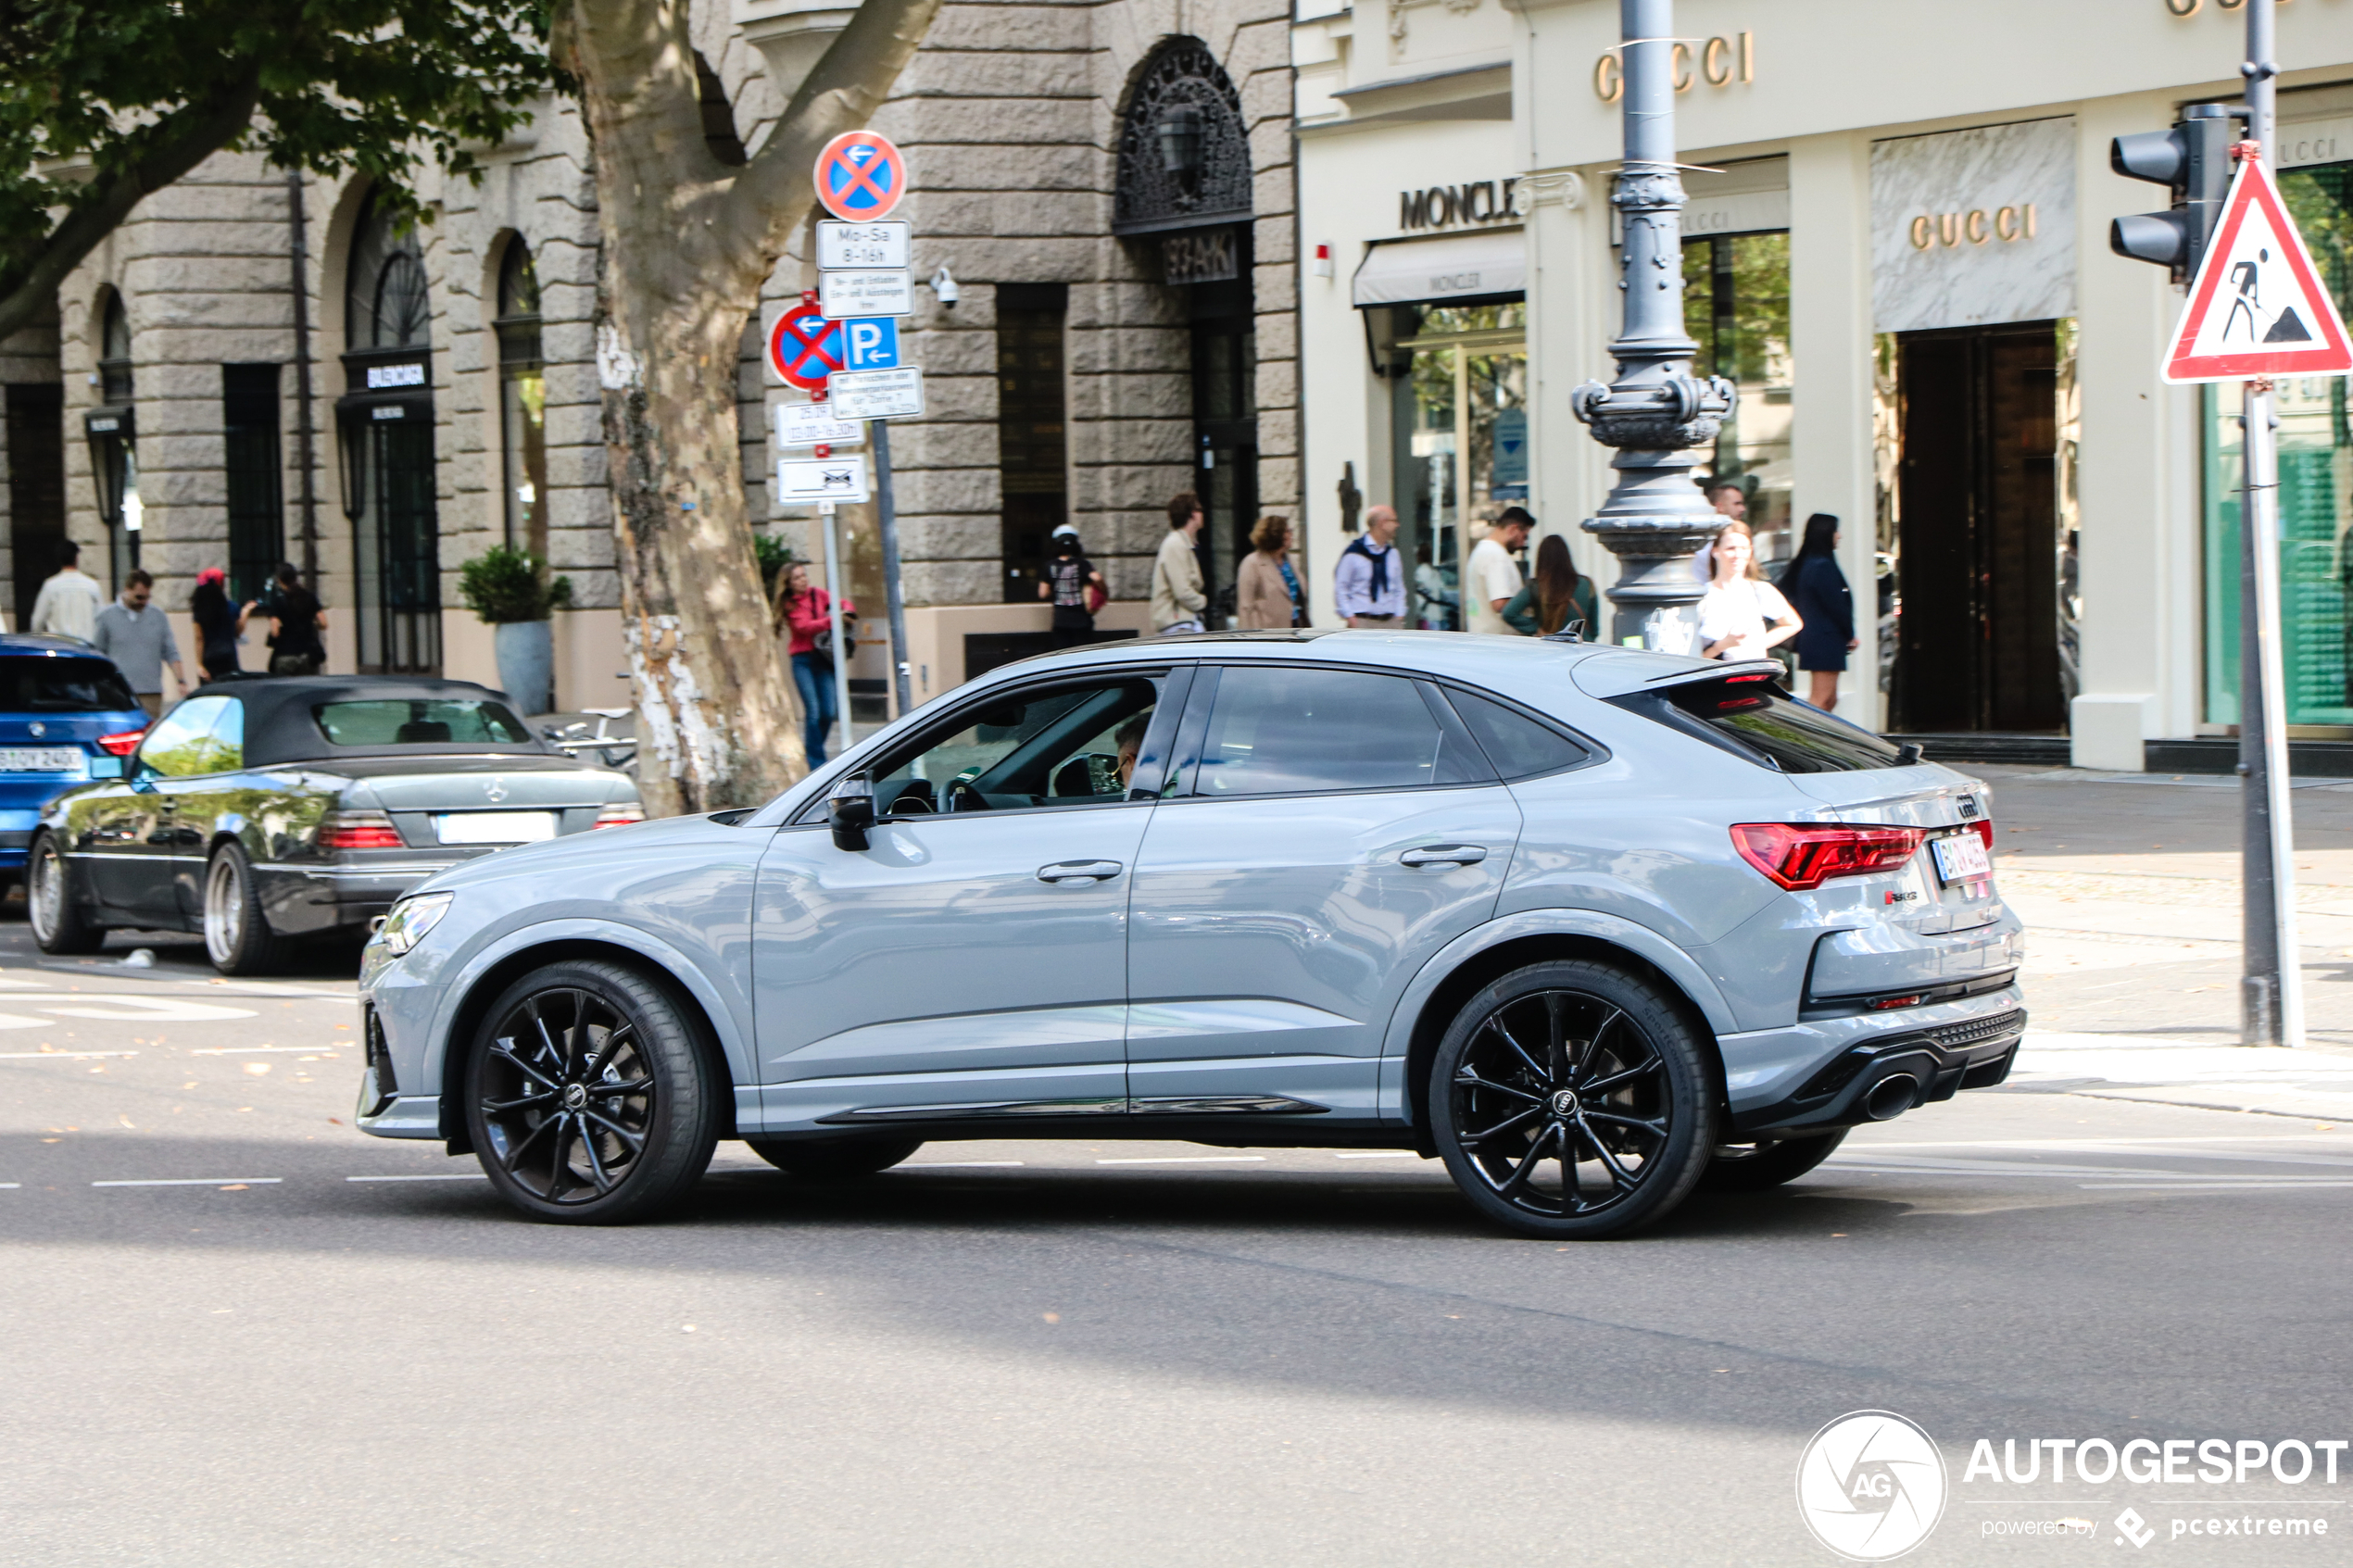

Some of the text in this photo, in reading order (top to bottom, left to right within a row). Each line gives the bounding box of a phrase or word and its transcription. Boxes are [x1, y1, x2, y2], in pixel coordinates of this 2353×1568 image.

[1593, 31, 1753, 102] GCCI
[2279, 138, 2335, 163] UCCI
[837, 228, 890, 242] Mo-Sa
[1910, 204, 2035, 250] GUCCI
[843, 248, 886, 262] 8-16h
[850, 323, 882, 364] P
